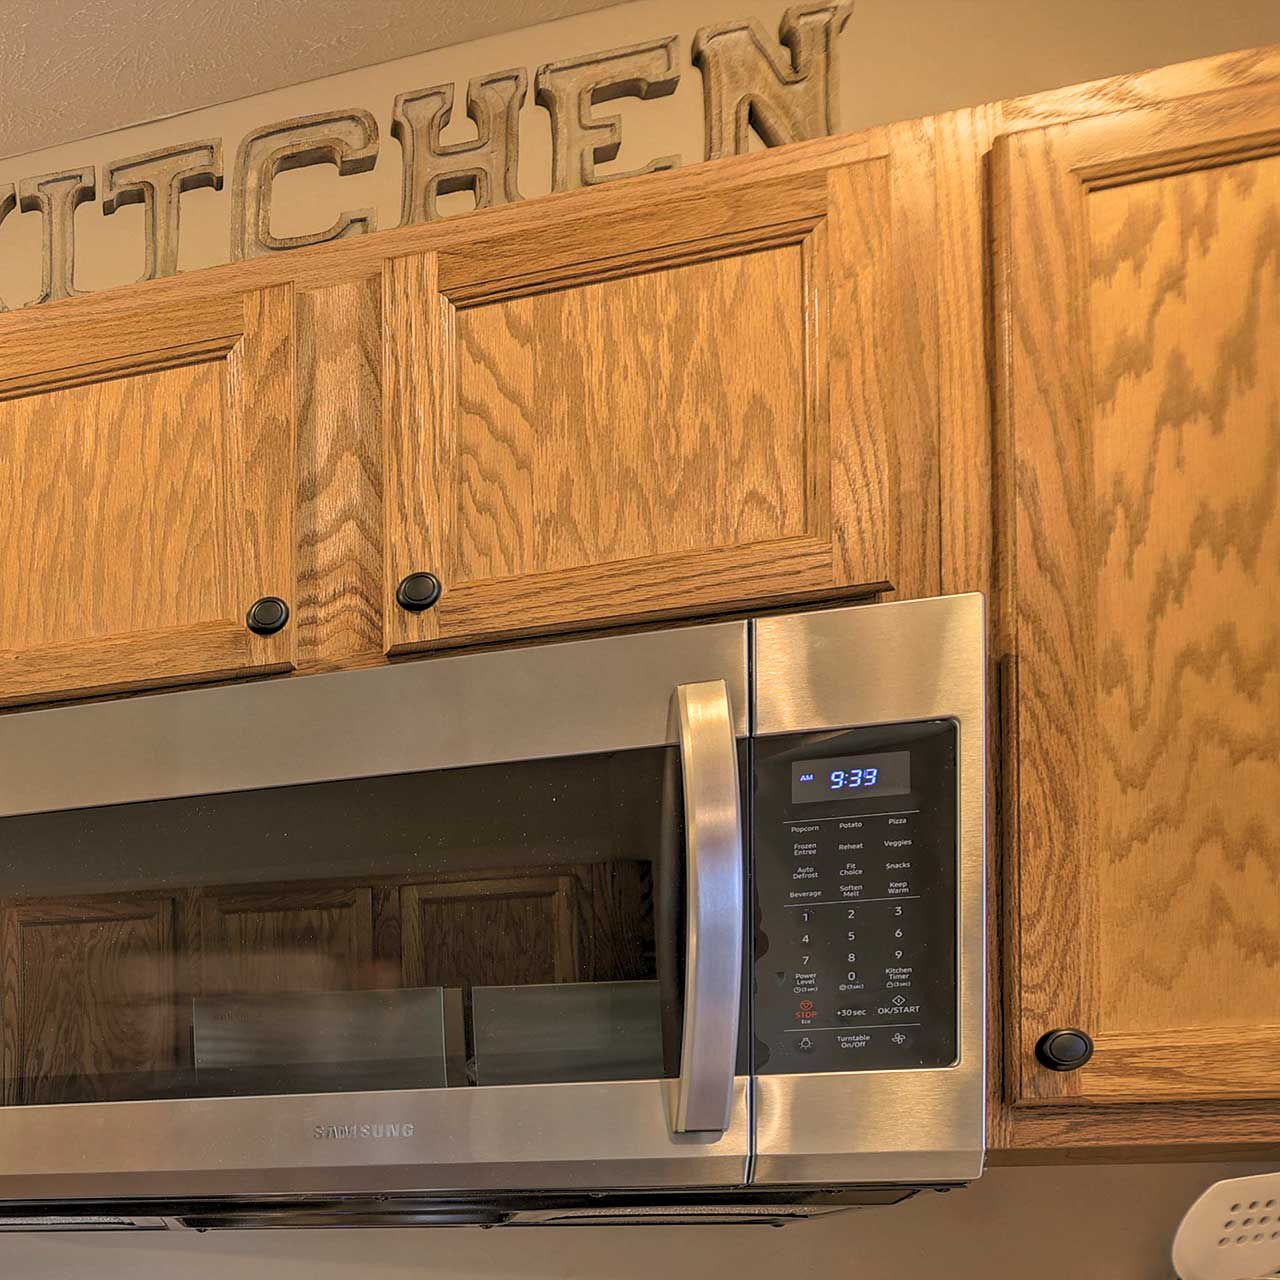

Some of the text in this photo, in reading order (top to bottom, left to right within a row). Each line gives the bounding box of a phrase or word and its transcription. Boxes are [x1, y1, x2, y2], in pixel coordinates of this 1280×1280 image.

[800, 768, 878, 789] AM 9:39
[791, 825, 819, 834] Popcorn
[839, 821, 863, 829] Potato
[884, 839, 913, 848] Veggies
[885, 861, 911, 869] Snacks
[792, 872, 819, 880] Defrost
[789, 890, 822, 898] Beverage
[848, 909, 855, 919] 2
[895, 906, 902, 916] 3
[802, 913, 808, 922] 1
[848, 931, 855, 940] 5
[895, 928, 903, 937] 6
[802, 934, 809, 943] 4
[847, 953, 856, 962] 8
[895, 950, 903, 959] 9
[802, 956, 809, 965] 7
[847, 971, 856, 981] 0
[877, 1006, 920, 1015] OK/START
[837, 1034, 871, 1042] Turntable
[841, 1041, 866, 1049] On/Off
[313, 1123, 416, 1139] SAMSUNG
